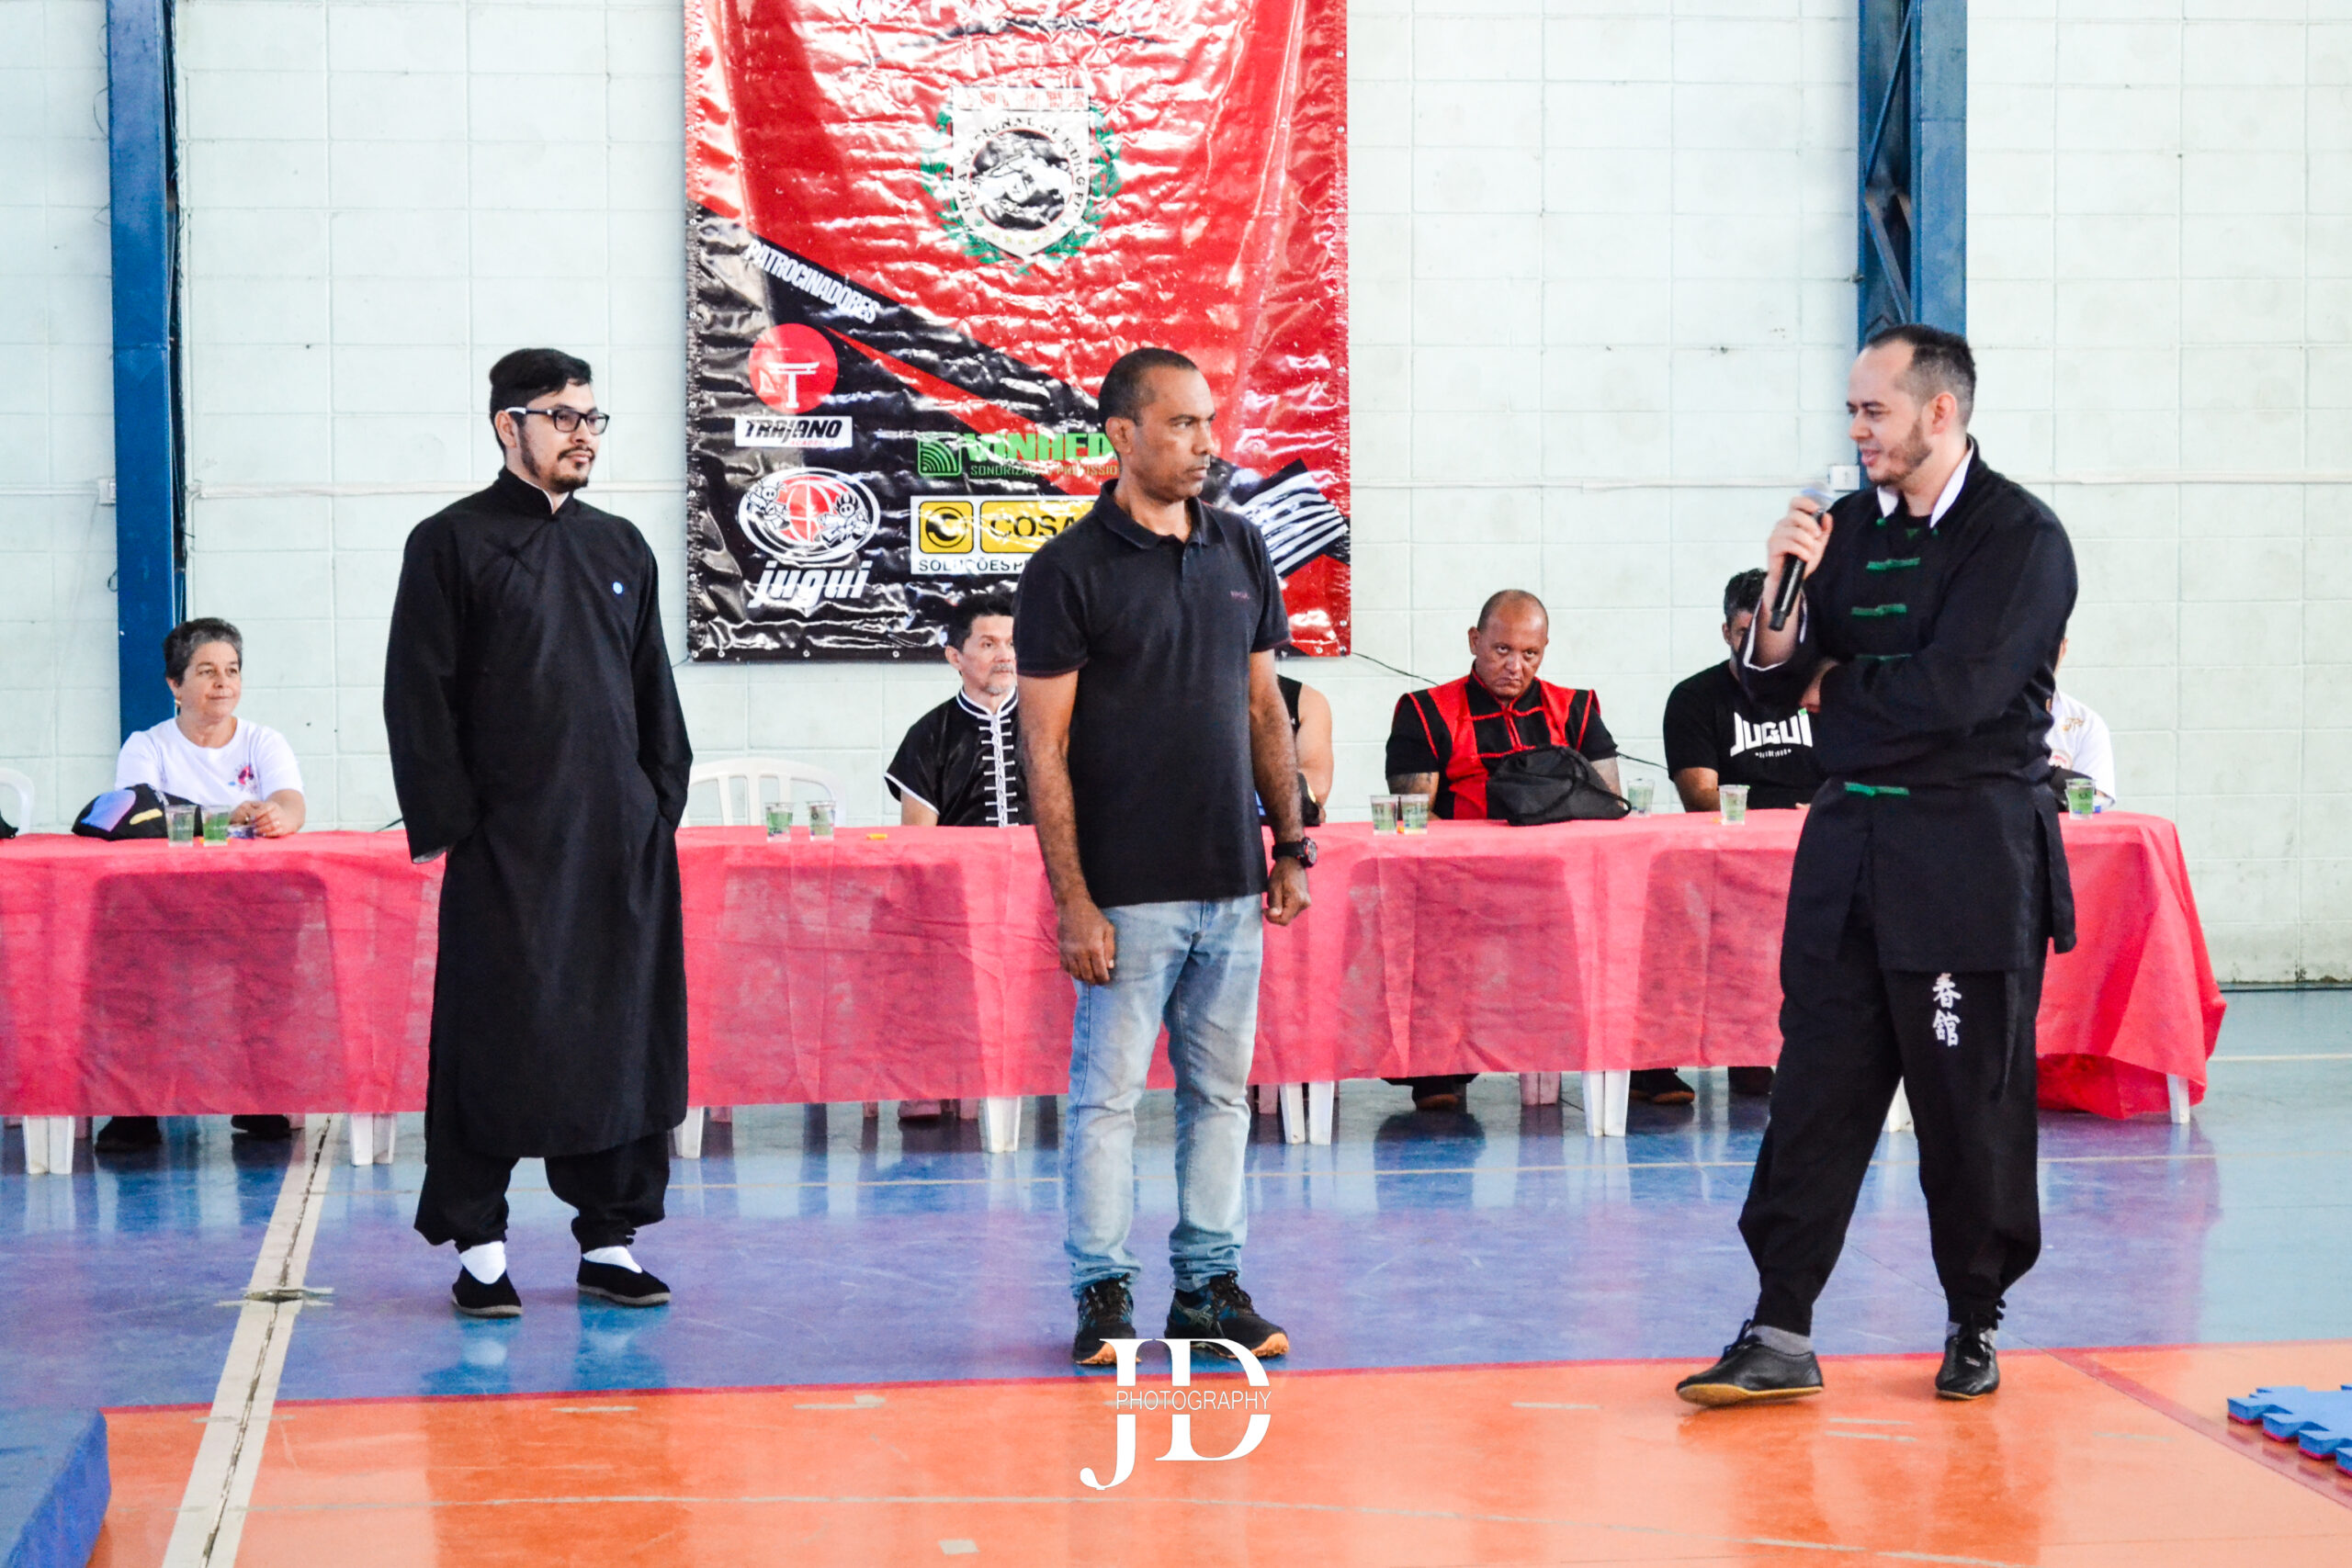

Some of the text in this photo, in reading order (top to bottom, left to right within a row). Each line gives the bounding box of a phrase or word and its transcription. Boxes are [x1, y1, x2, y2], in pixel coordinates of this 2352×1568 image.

[745, 238, 881, 324] PATROCINADORES
[745, 419, 843, 444] TRAJANO
[1730, 707, 1814, 758] JUGUI
